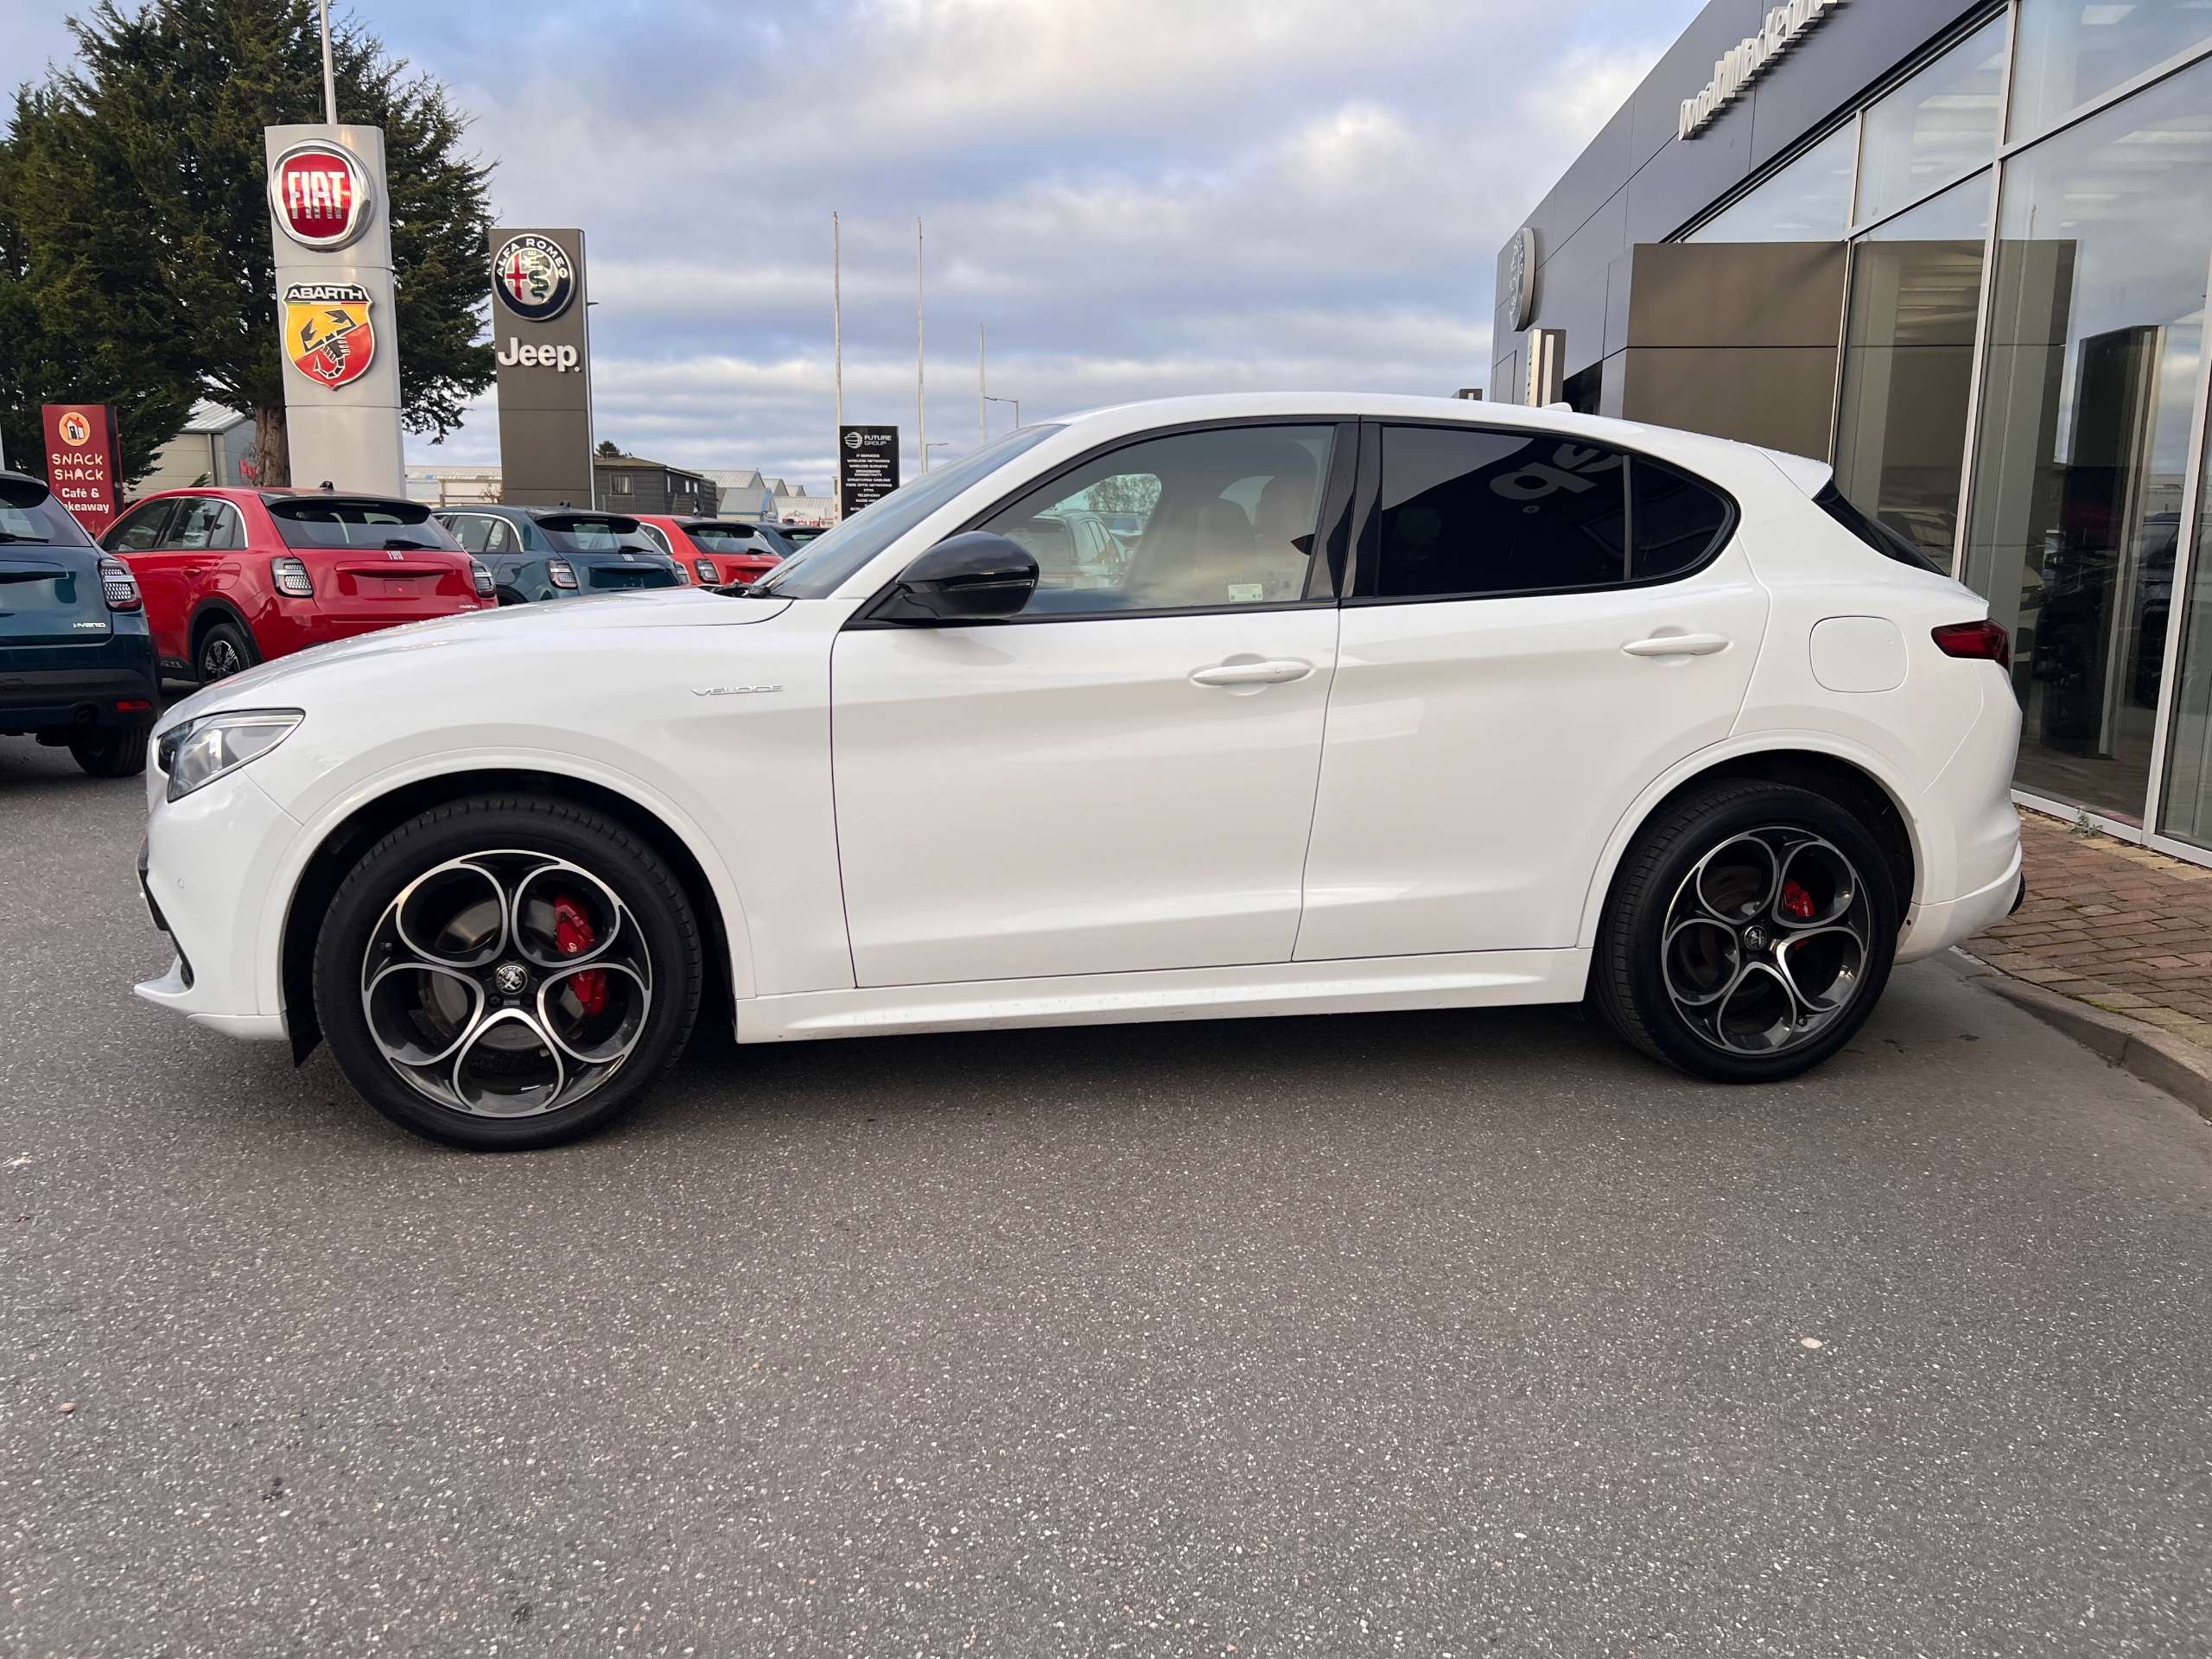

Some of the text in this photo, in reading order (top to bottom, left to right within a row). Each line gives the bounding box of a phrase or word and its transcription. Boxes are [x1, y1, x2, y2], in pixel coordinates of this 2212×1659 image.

[288, 171, 346, 219] FIAT
[496, 238, 569, 278] ALFA ROMEO
[288, 286, 363, 300] ABARTH
[52, 453, 104, 465] SNACK
[54, 468, 104, 480] SHACK
[61, 487, 99, 499] Café &
[63, 500, 110, 514] keaway
